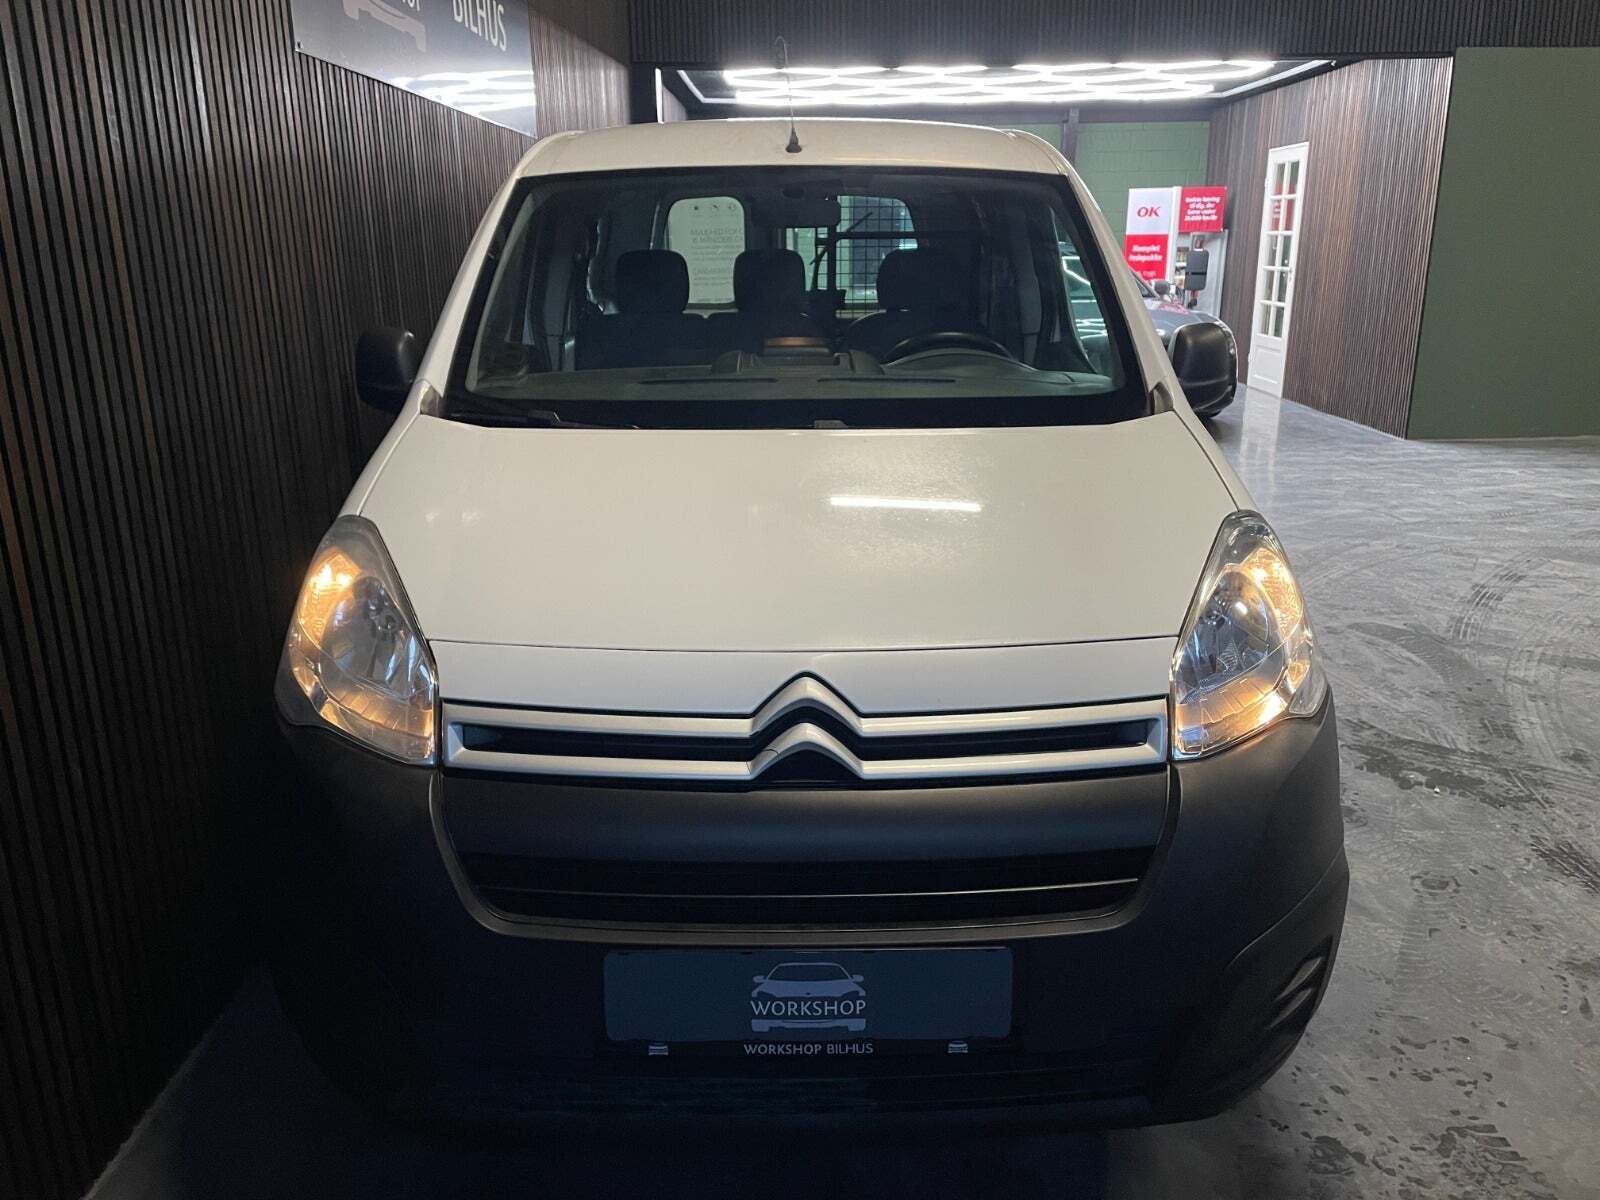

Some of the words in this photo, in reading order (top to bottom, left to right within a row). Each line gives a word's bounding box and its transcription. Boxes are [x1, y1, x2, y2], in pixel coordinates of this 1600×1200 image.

[1137, 206, 1161, 217] OK
[750, 999, 866, 1016] WORKSHOP
[743, 1043, 822, 1055] WORKSHOP
[826, 1043, 874, 1055] BILHUS
